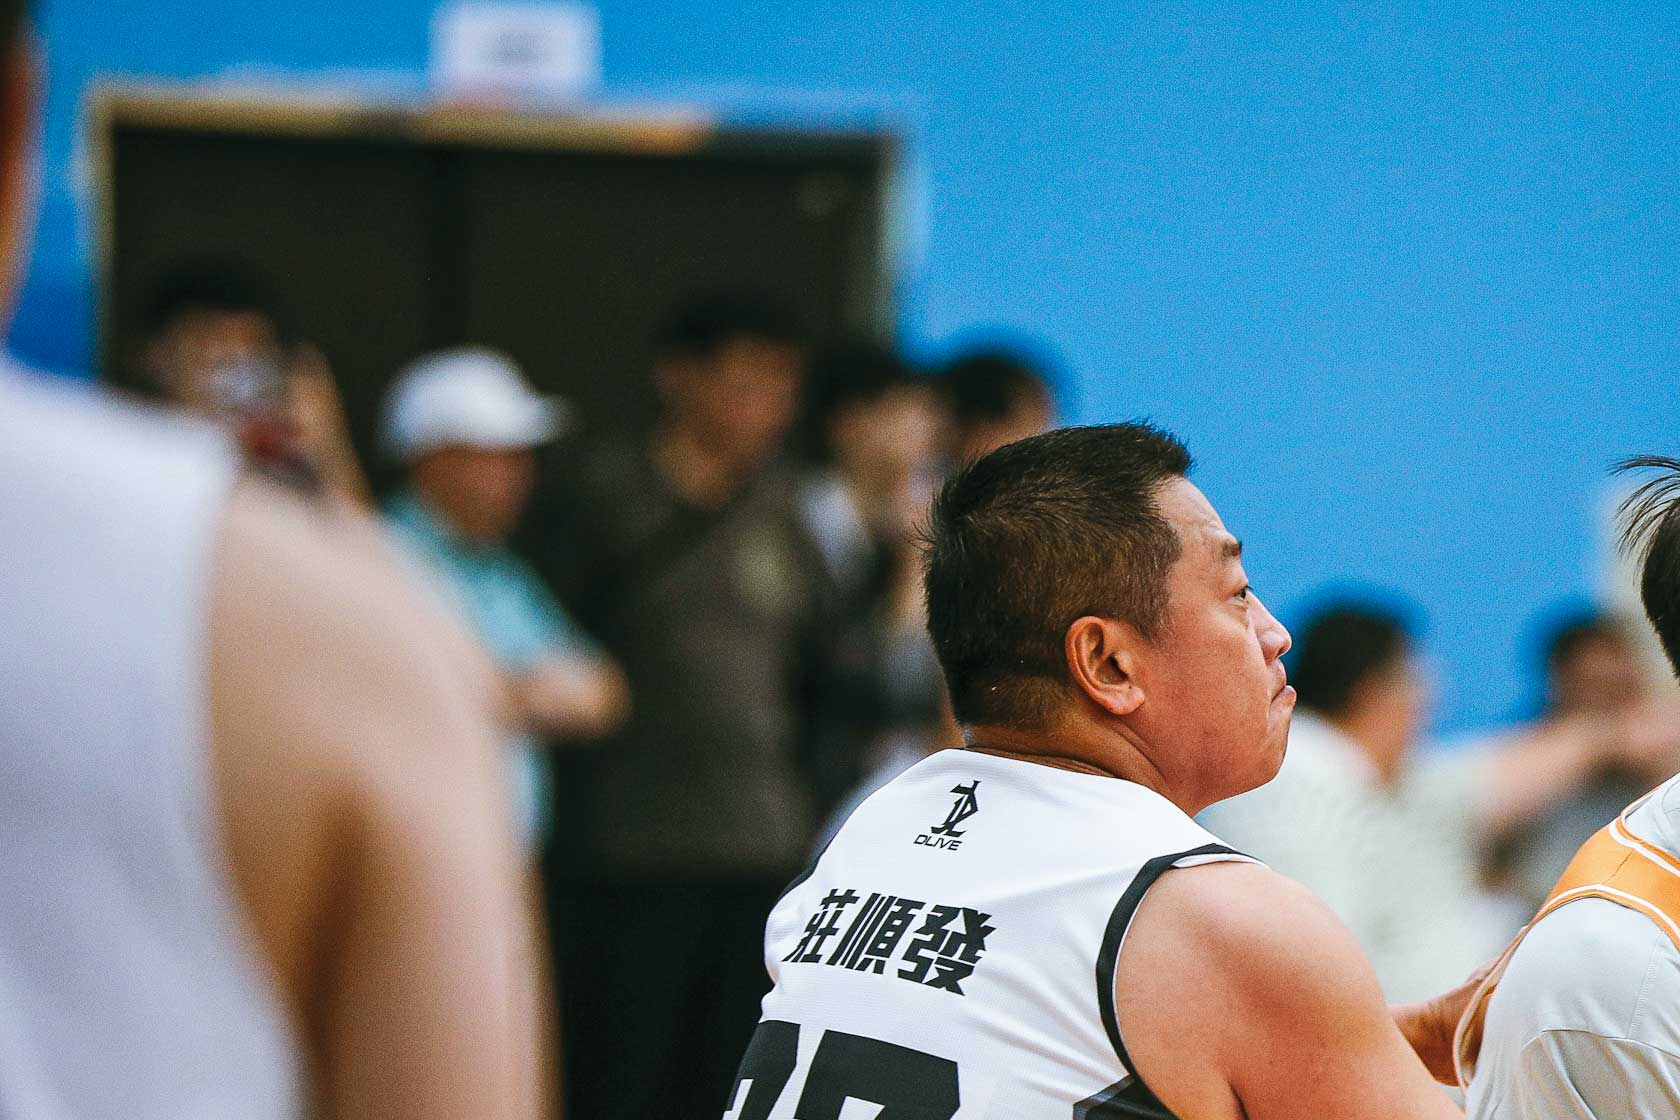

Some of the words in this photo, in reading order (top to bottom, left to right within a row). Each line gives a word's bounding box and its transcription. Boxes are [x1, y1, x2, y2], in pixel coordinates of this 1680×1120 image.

[913, 834, 963, 851] DLIVE
[779, 888, 997, 997] 莊順發
